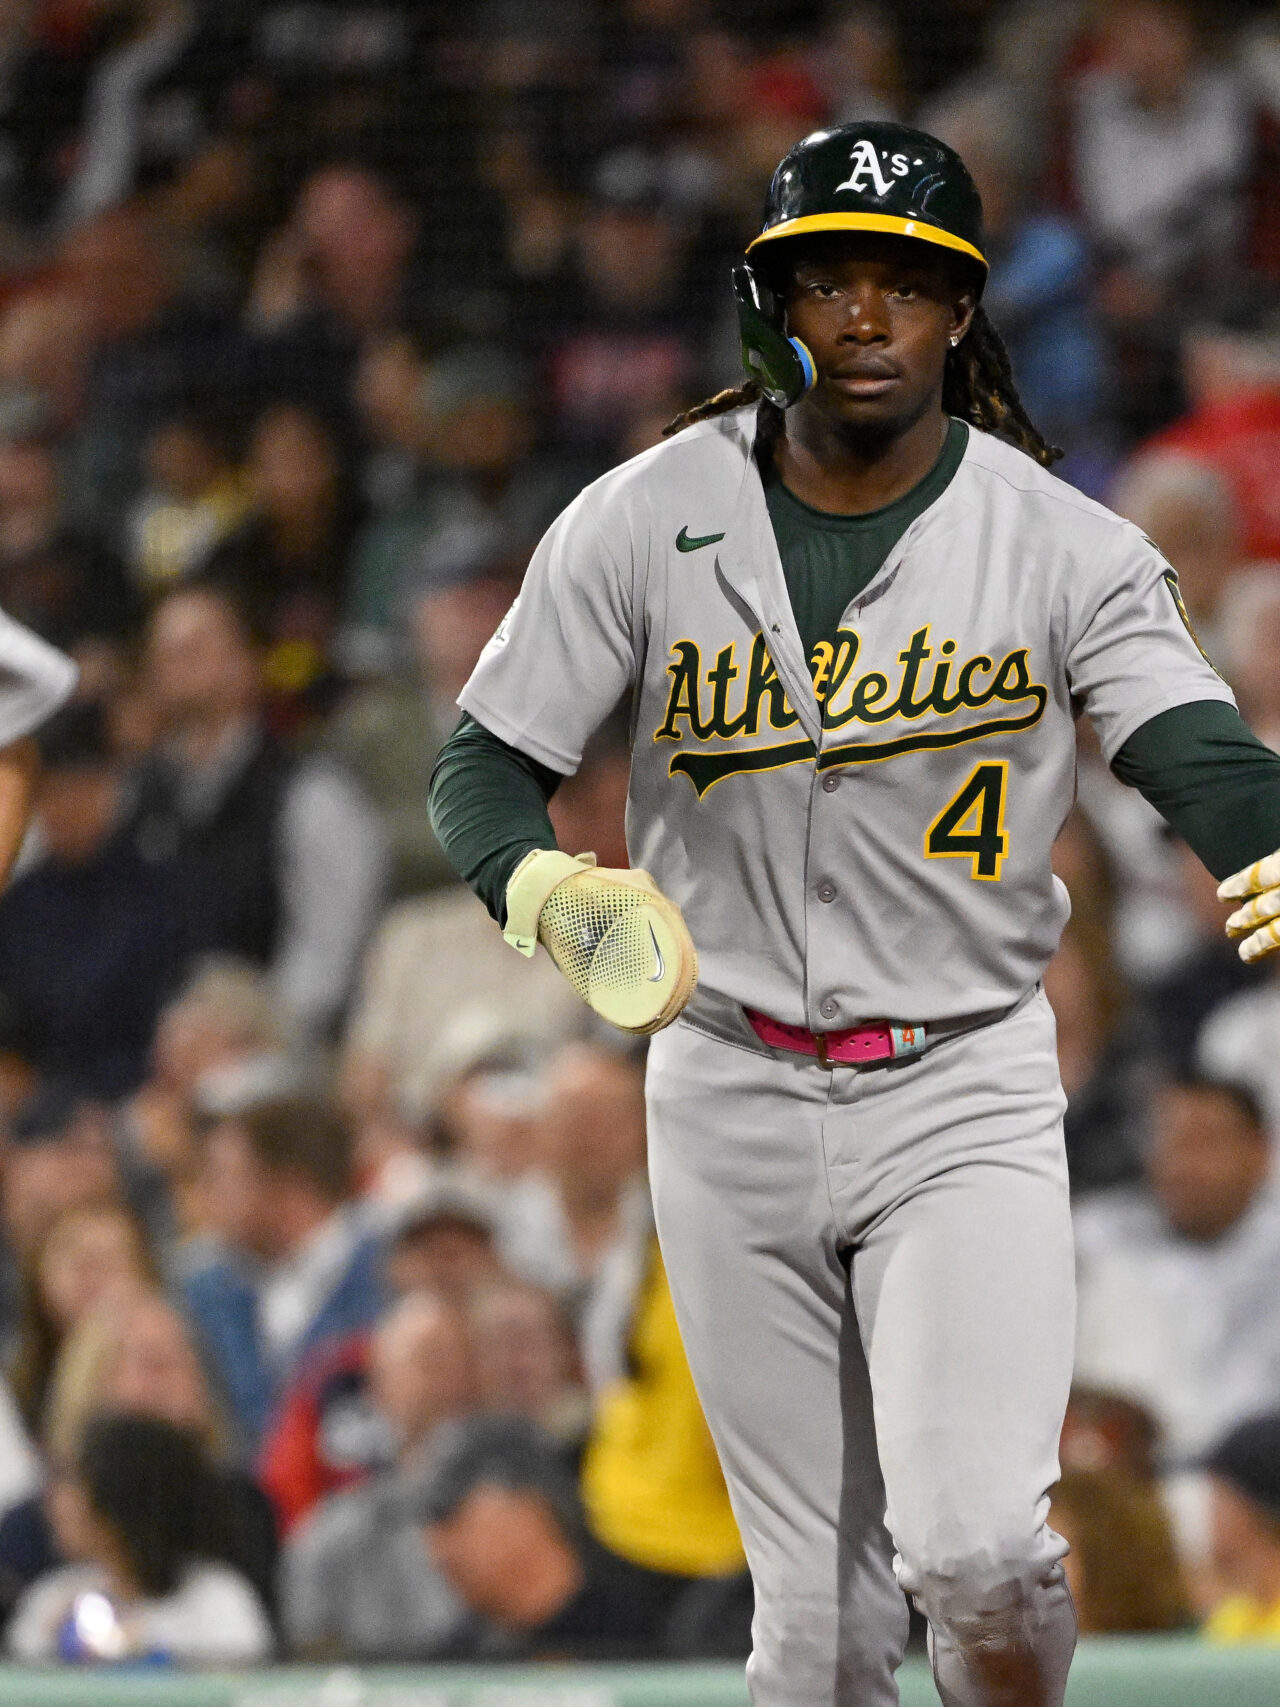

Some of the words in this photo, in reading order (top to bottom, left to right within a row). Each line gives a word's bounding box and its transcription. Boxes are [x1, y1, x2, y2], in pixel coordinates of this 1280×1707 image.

[833, 140, 909, 197] A's
[653, 623, 1048, 746] Athletics
[923, 760, 1010, 882] 4
